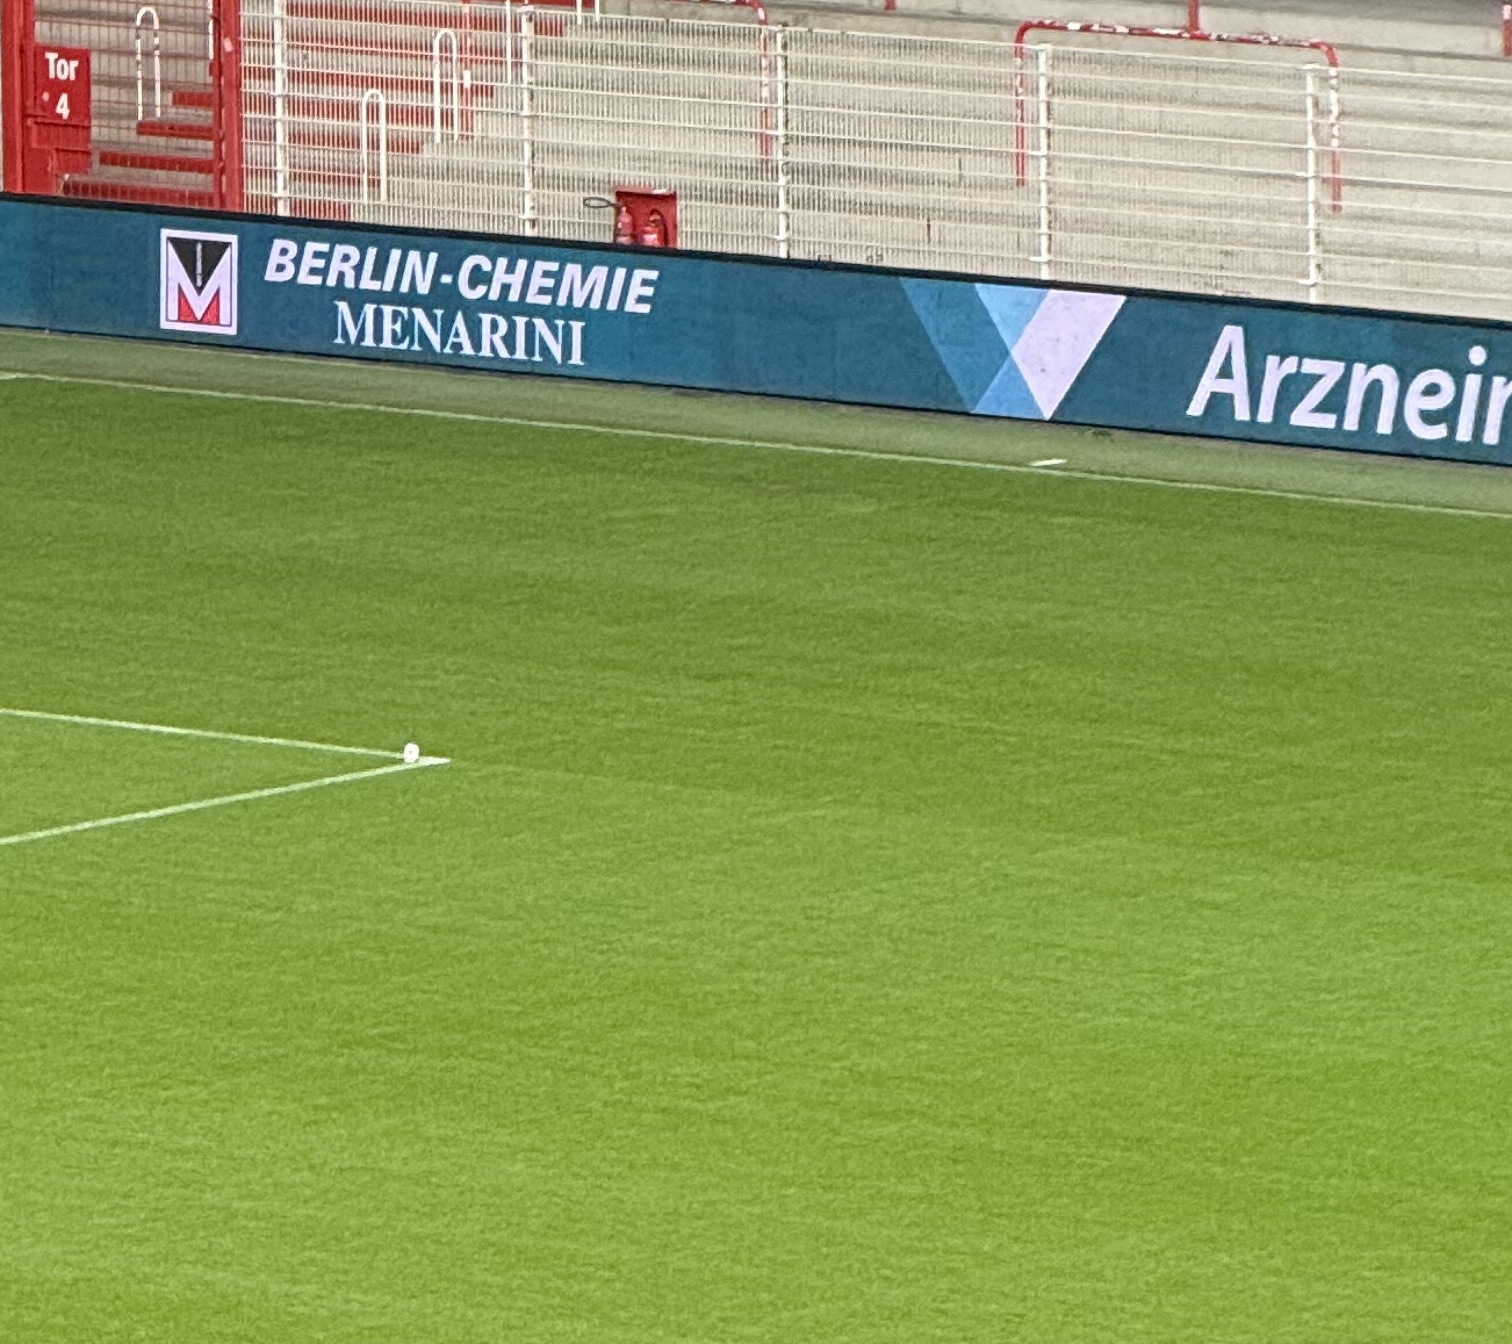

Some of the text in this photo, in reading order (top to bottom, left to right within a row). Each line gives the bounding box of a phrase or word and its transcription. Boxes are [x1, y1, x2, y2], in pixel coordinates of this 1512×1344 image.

[45, 53, 78, 82] Tor
[55, 92, 70, 119] 4
[264, 238, 659, 314] BERLIN-CHEMIE
[333, 300, 586, 366] MENARINI
